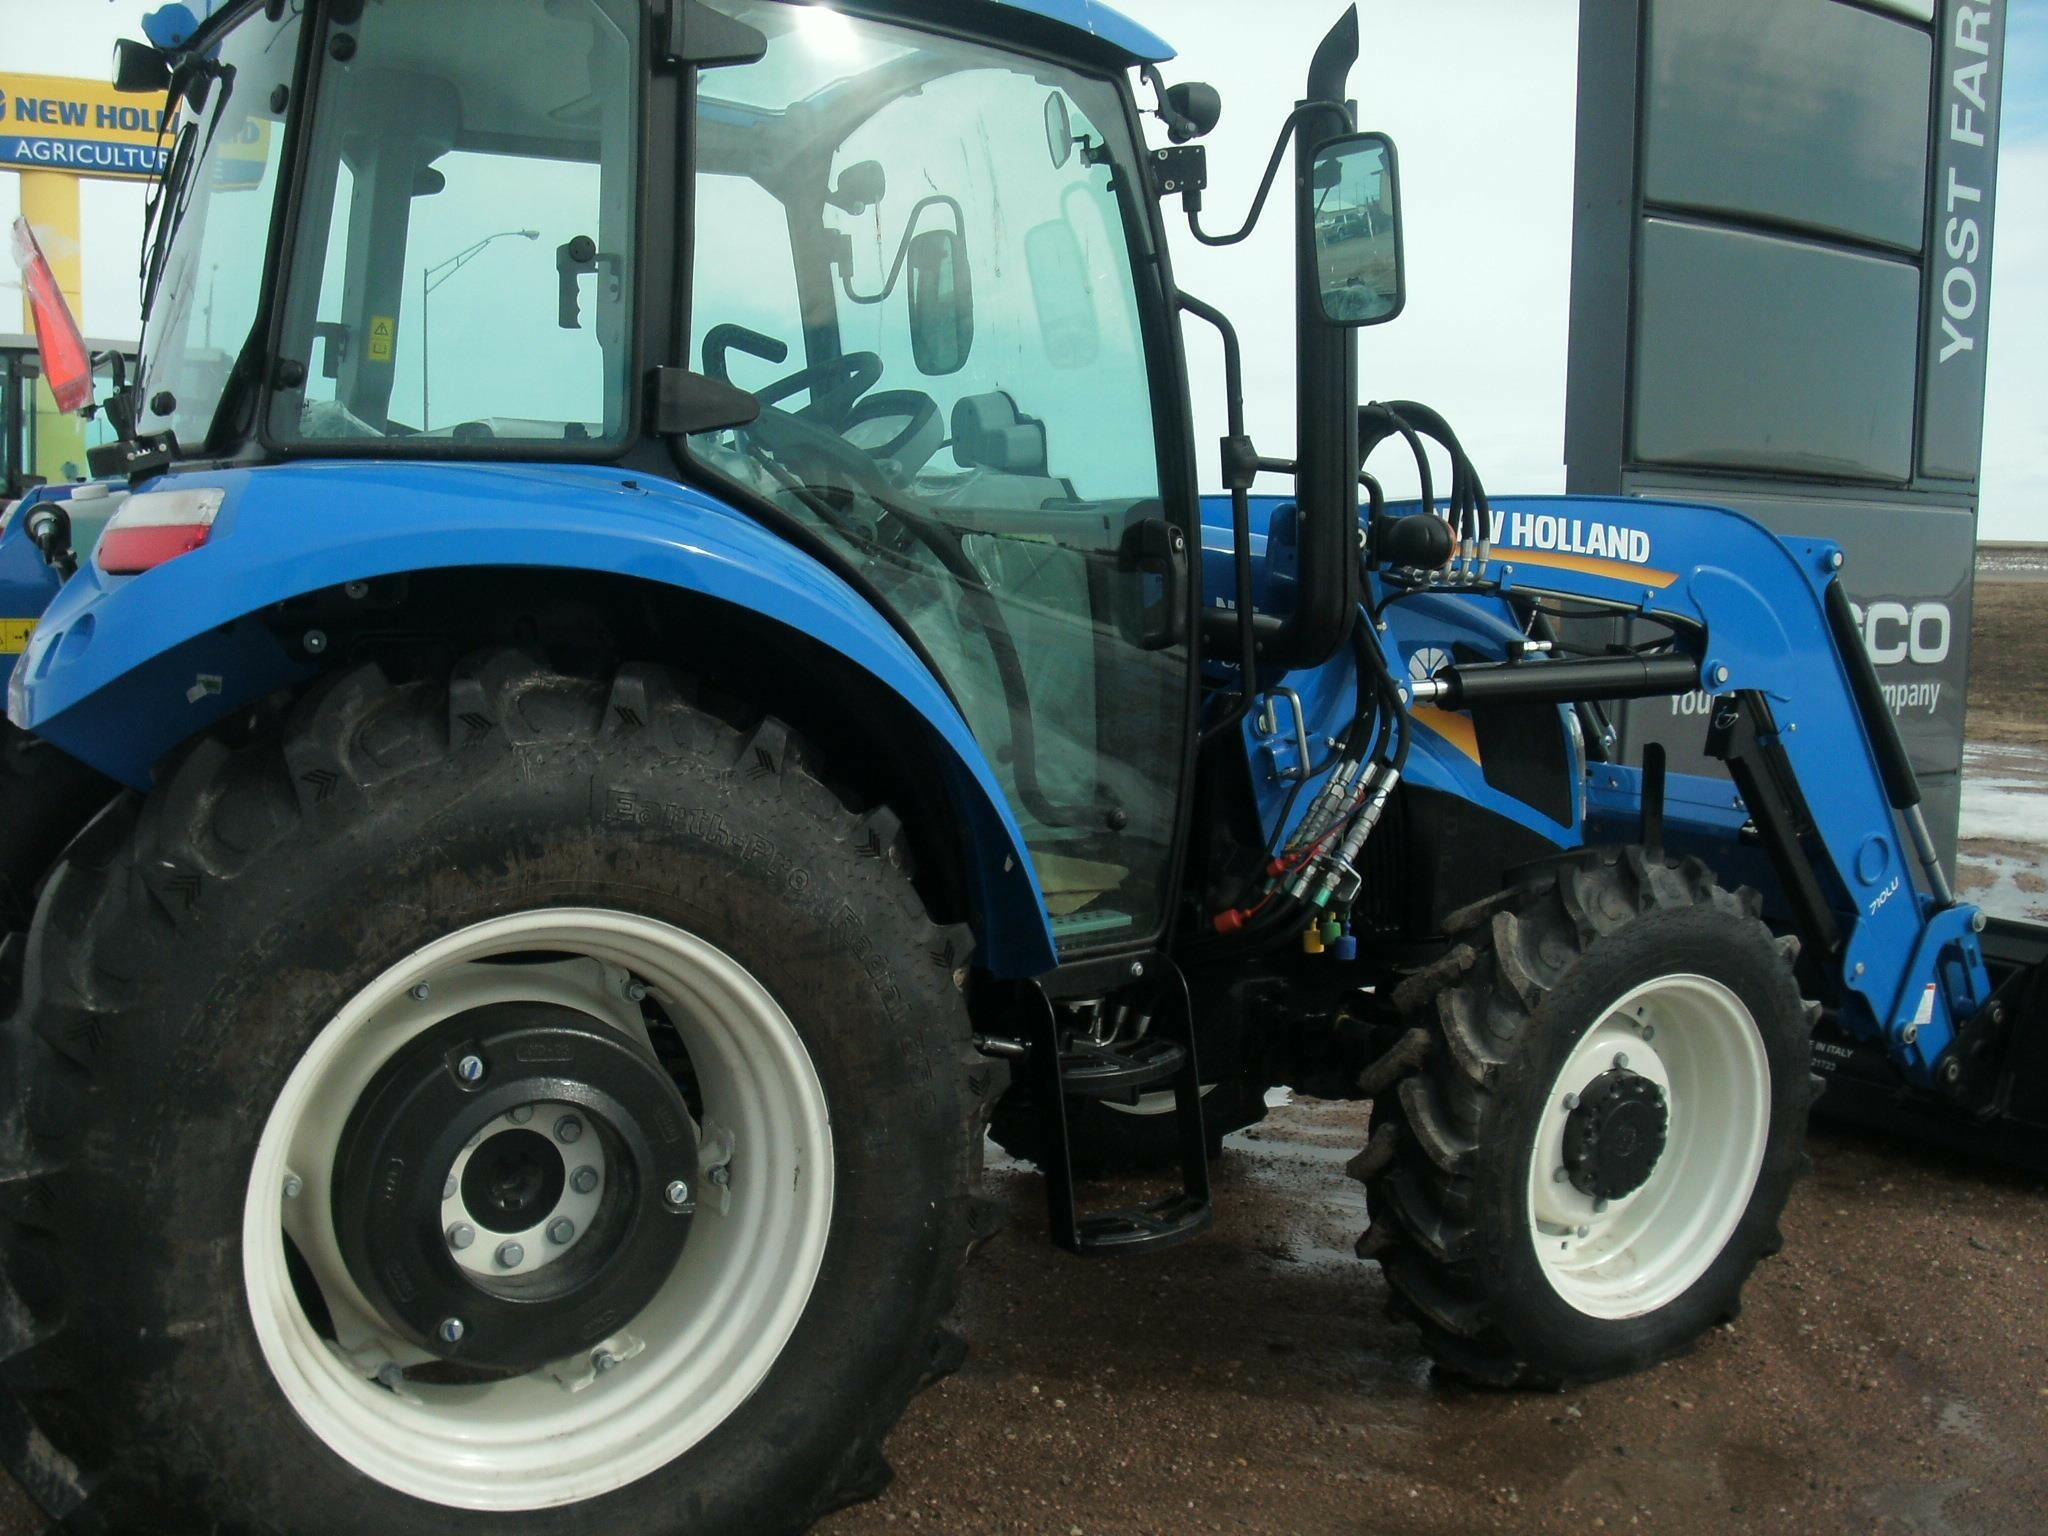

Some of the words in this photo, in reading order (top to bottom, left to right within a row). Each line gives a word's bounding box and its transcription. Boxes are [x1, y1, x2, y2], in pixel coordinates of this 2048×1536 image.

[1950, 0, 1991, 147] FAR
[15, 96, 88, 127] NEW
[1939, 167, 1981, 364] YOST
[1511, 512, 1650, 563] HOLLAND
[1880, 683, 1942, 715] mpany
[1826, 1044, 1855, 1059] ITALY
